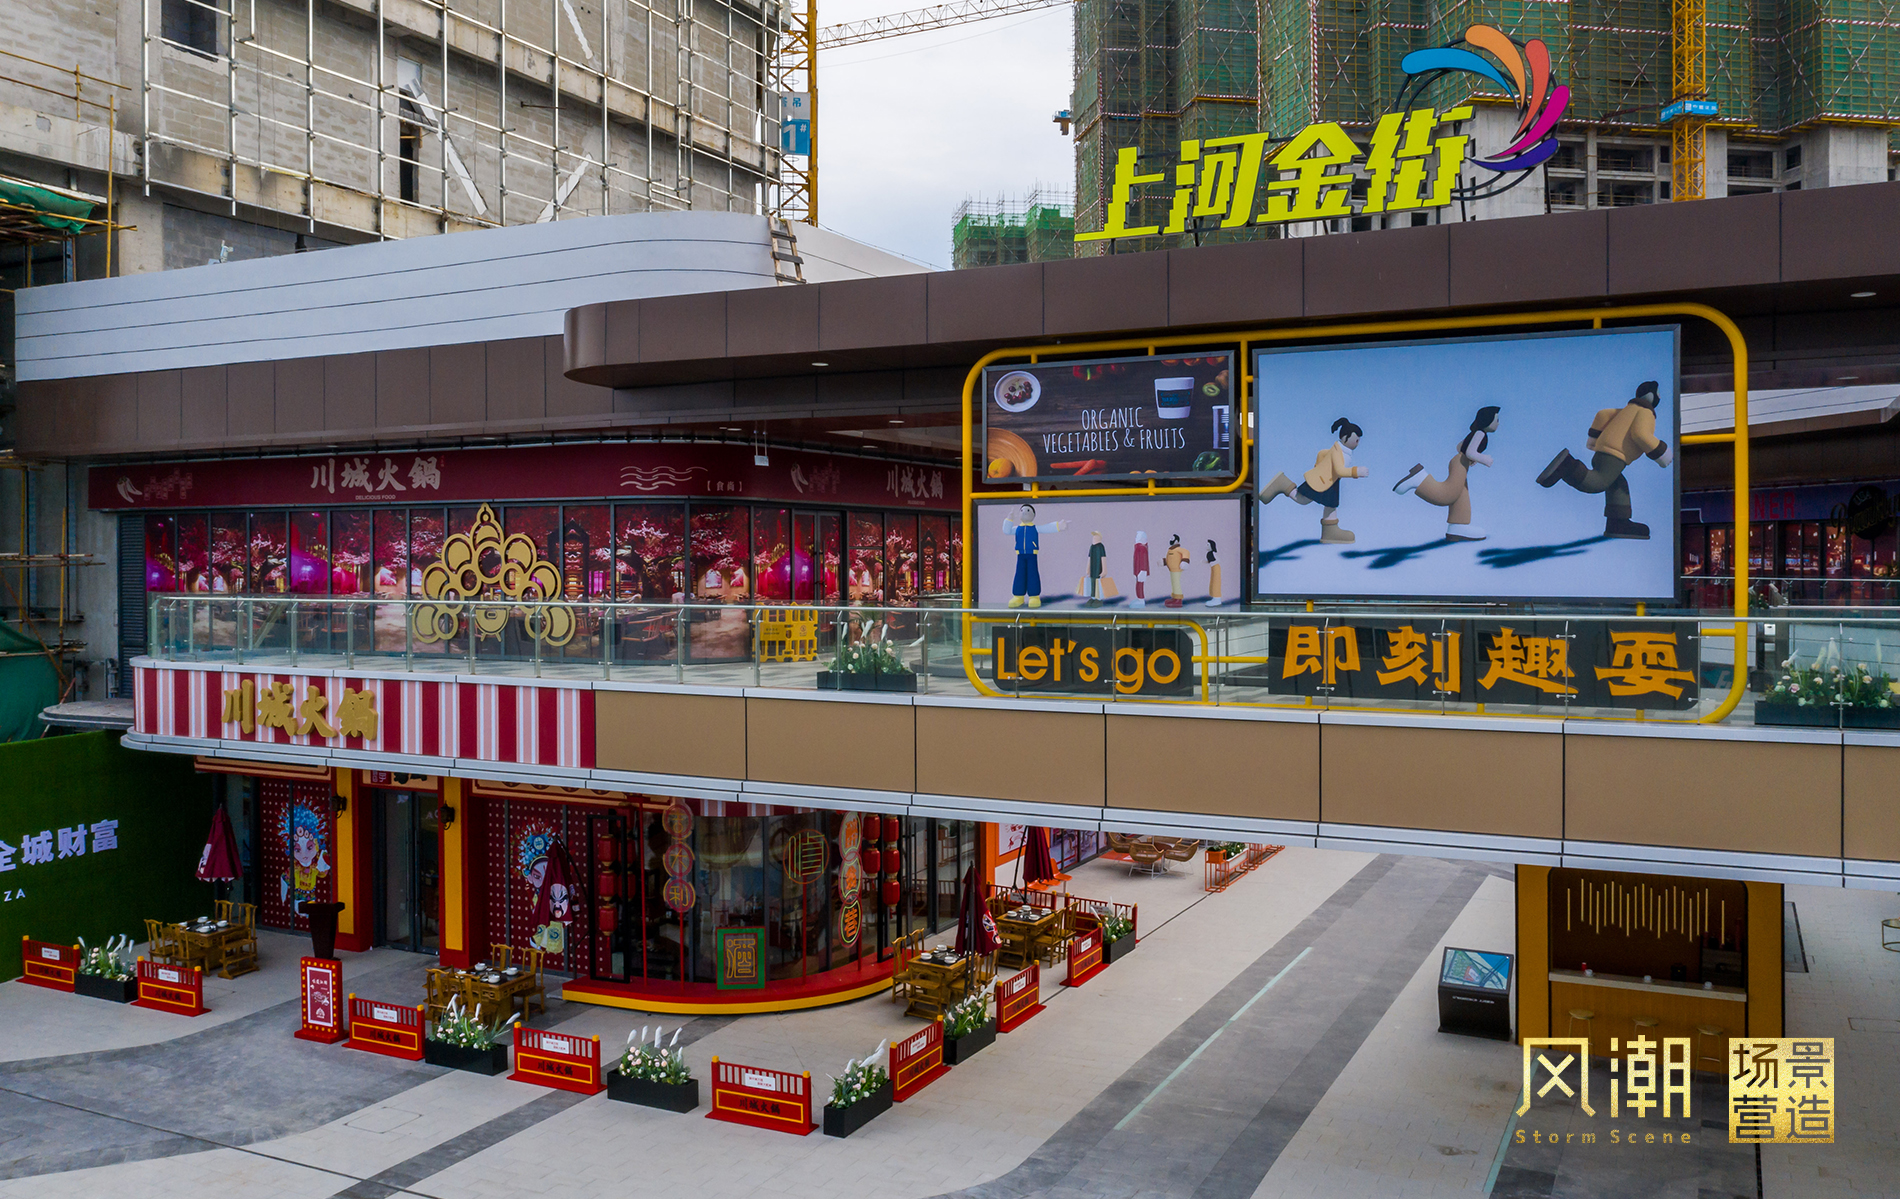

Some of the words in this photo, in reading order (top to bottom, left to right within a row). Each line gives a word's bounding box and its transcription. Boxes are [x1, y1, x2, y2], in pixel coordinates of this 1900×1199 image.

[1074, 105, 1474, 242] 上河金街
[1043, 430, 1119, 454] VEGETABLES
[1123, 428, 1136, 448] &
[1140, 427, 1186, 450] FRUITS
[1081, 407, 1144, 430] ORGANIC
[997, 637, 1100, 682] Let's
[1111, 647, 1181, 694] go
[1282, 624, 1697, 699] 即刻趣耍
